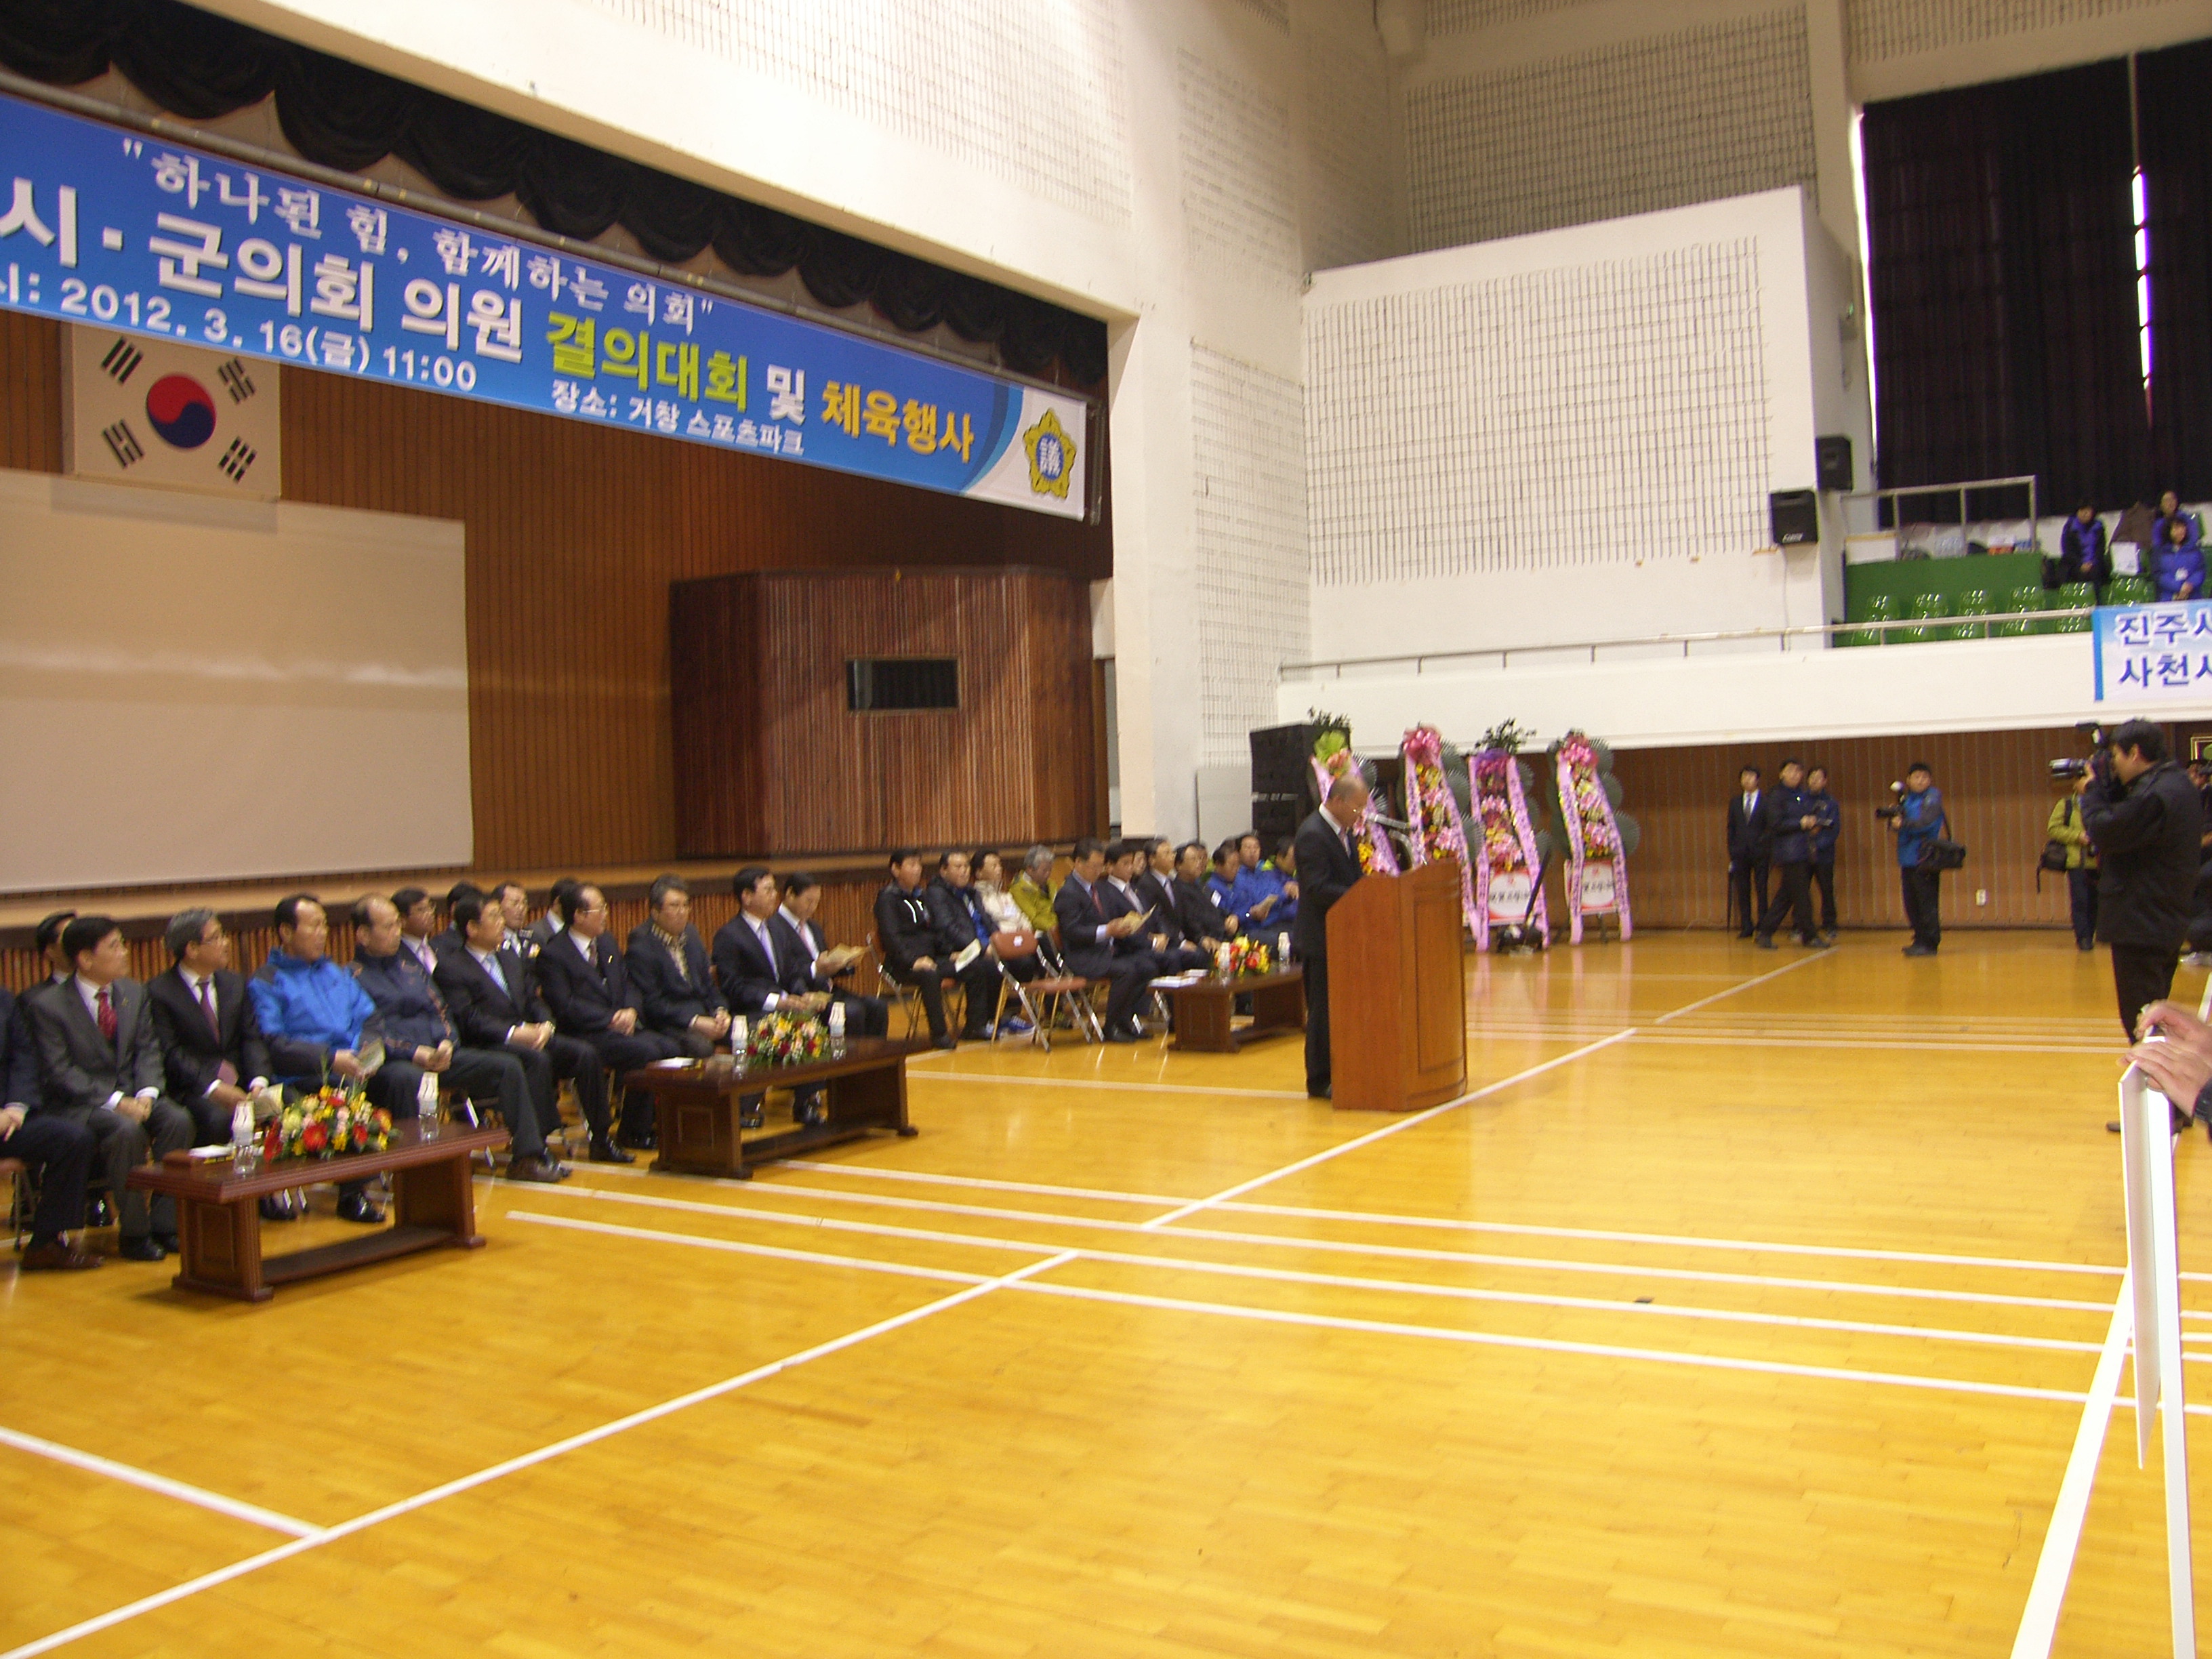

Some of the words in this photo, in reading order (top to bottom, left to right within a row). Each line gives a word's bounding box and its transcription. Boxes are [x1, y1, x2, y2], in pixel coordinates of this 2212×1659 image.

[346, 204, 409, 264] 힘,
[432, 227, 609, 312] 함께하는
[623, 282, 714, 336] 의회"
[61, 278, 187, 337] 2012.
[204, 308, 243, 348] 3.
[260, 319, 370, 373] 16(금)
[383, 345, 477, 392] 11:00
[401, 278, 523, 364] 의원
[546, 310, 747, 413] 결의대회
[766, 364, 806, 426] 및
[820, 380, 976, 464] 체육행사
[552, 378, 617, 419] 장소:
[629, 396, 680, 434] 거창
[687, 409, 804, 457] 스포츠파크
